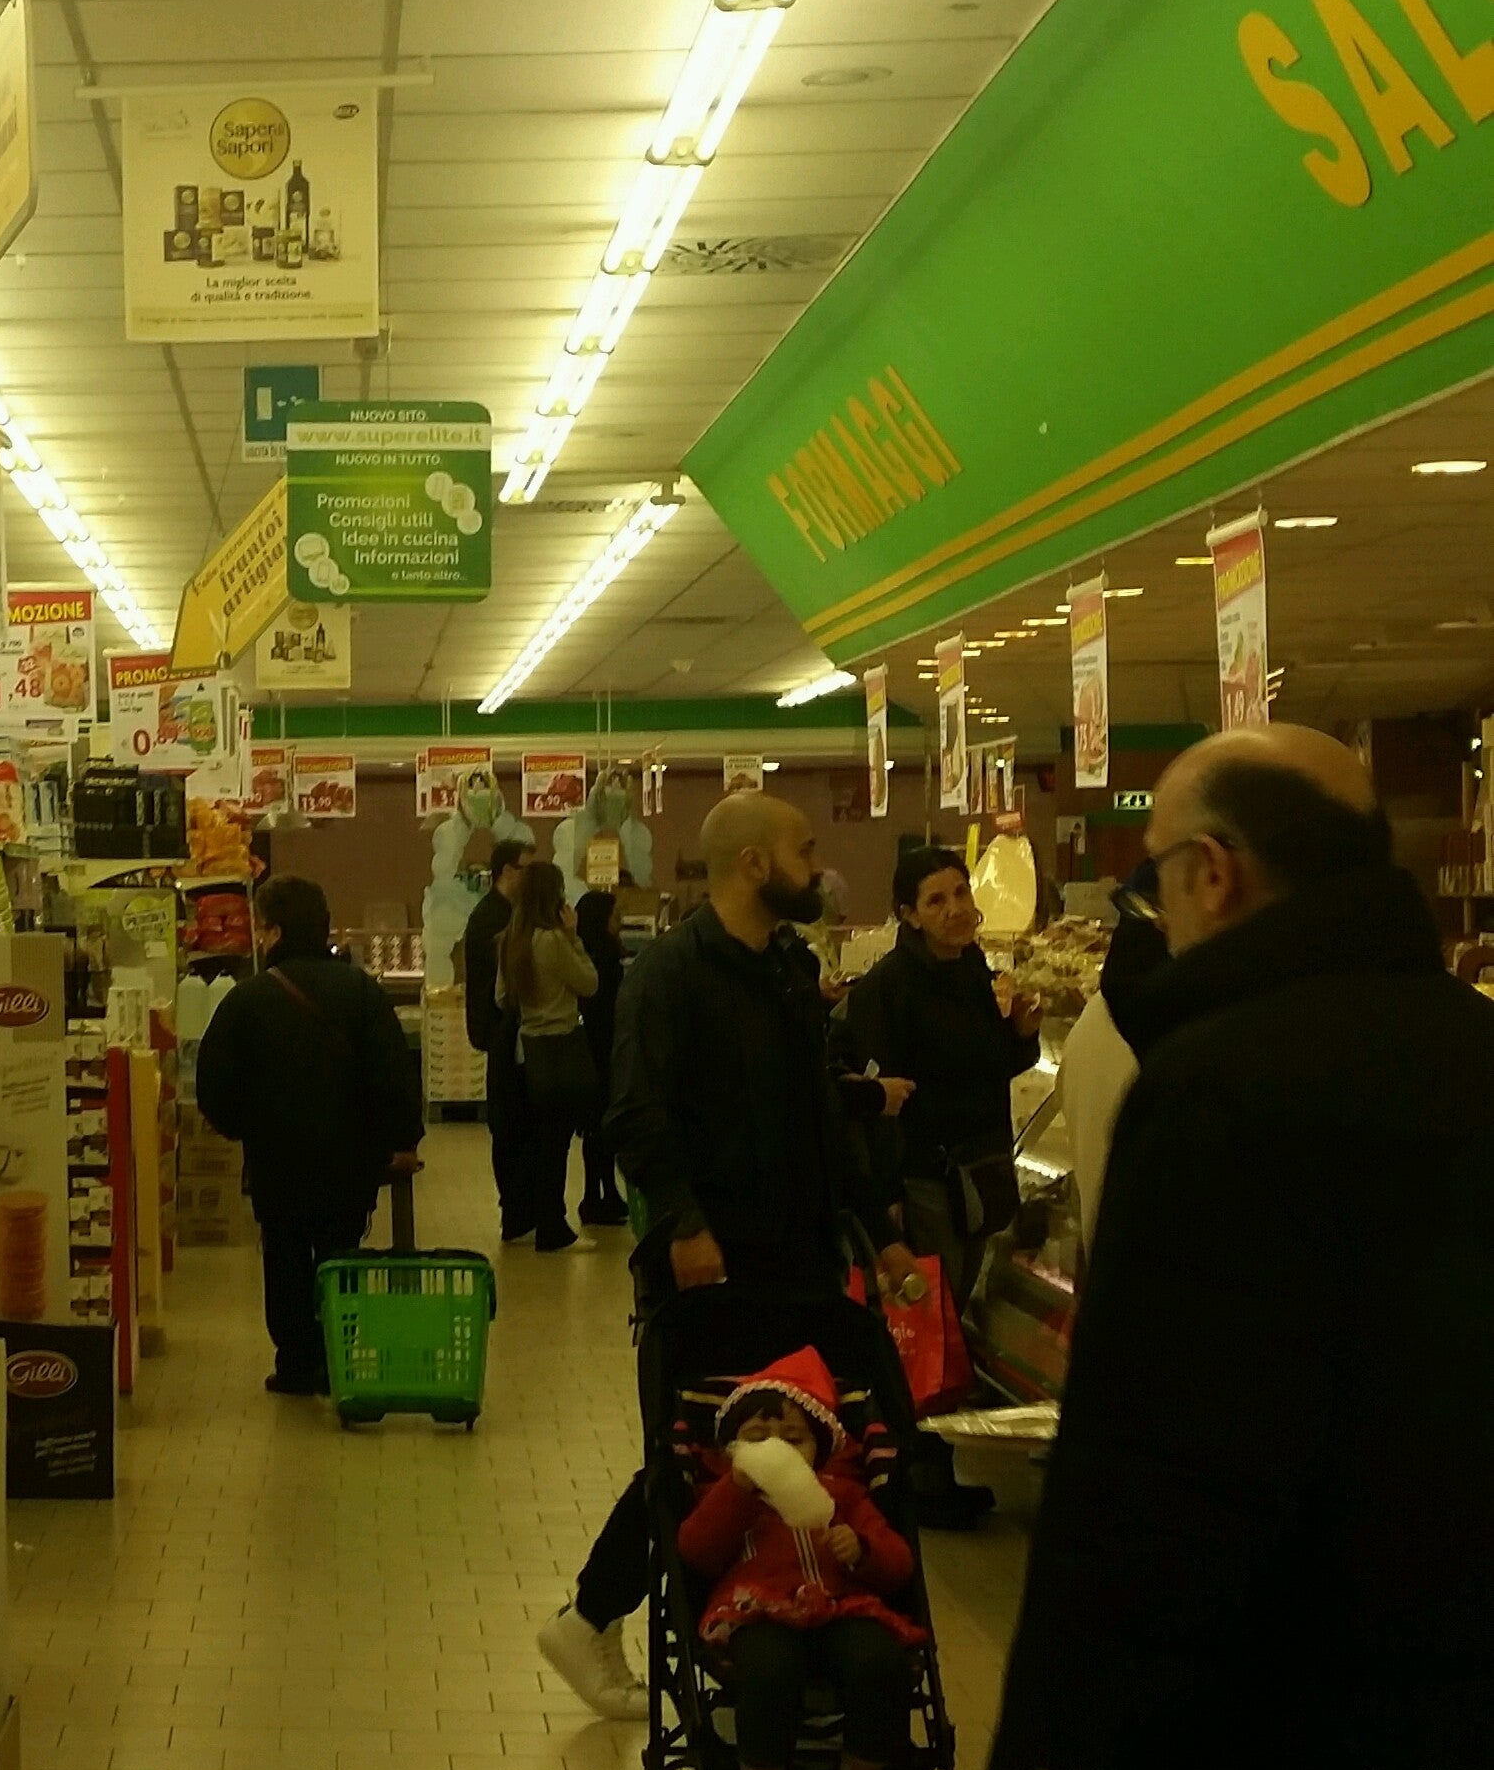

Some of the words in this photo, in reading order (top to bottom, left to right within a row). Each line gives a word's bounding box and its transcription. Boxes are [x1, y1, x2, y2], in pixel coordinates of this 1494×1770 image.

[349, 409, 395, 423] NUOVO
[296, 427, 483, 446] www.superelite.it
[335, 453, 381, 466] NUOVO
[383, 453, 396, 465] IN
[399, 452, 441, 465] TUTTO
[766, 363, 963, 564] FORMAGGI
[317, 493, 411, 510] Promozioni
[329, 511, 396, 531] Consigli
[401, 511, 434, 528] utili
[342, 531, 379, 546] Idee
[384, 531, 398, 546] in
[402, 531, 459, 547] cucina
[355, 549, 459, 566] Informazioni
